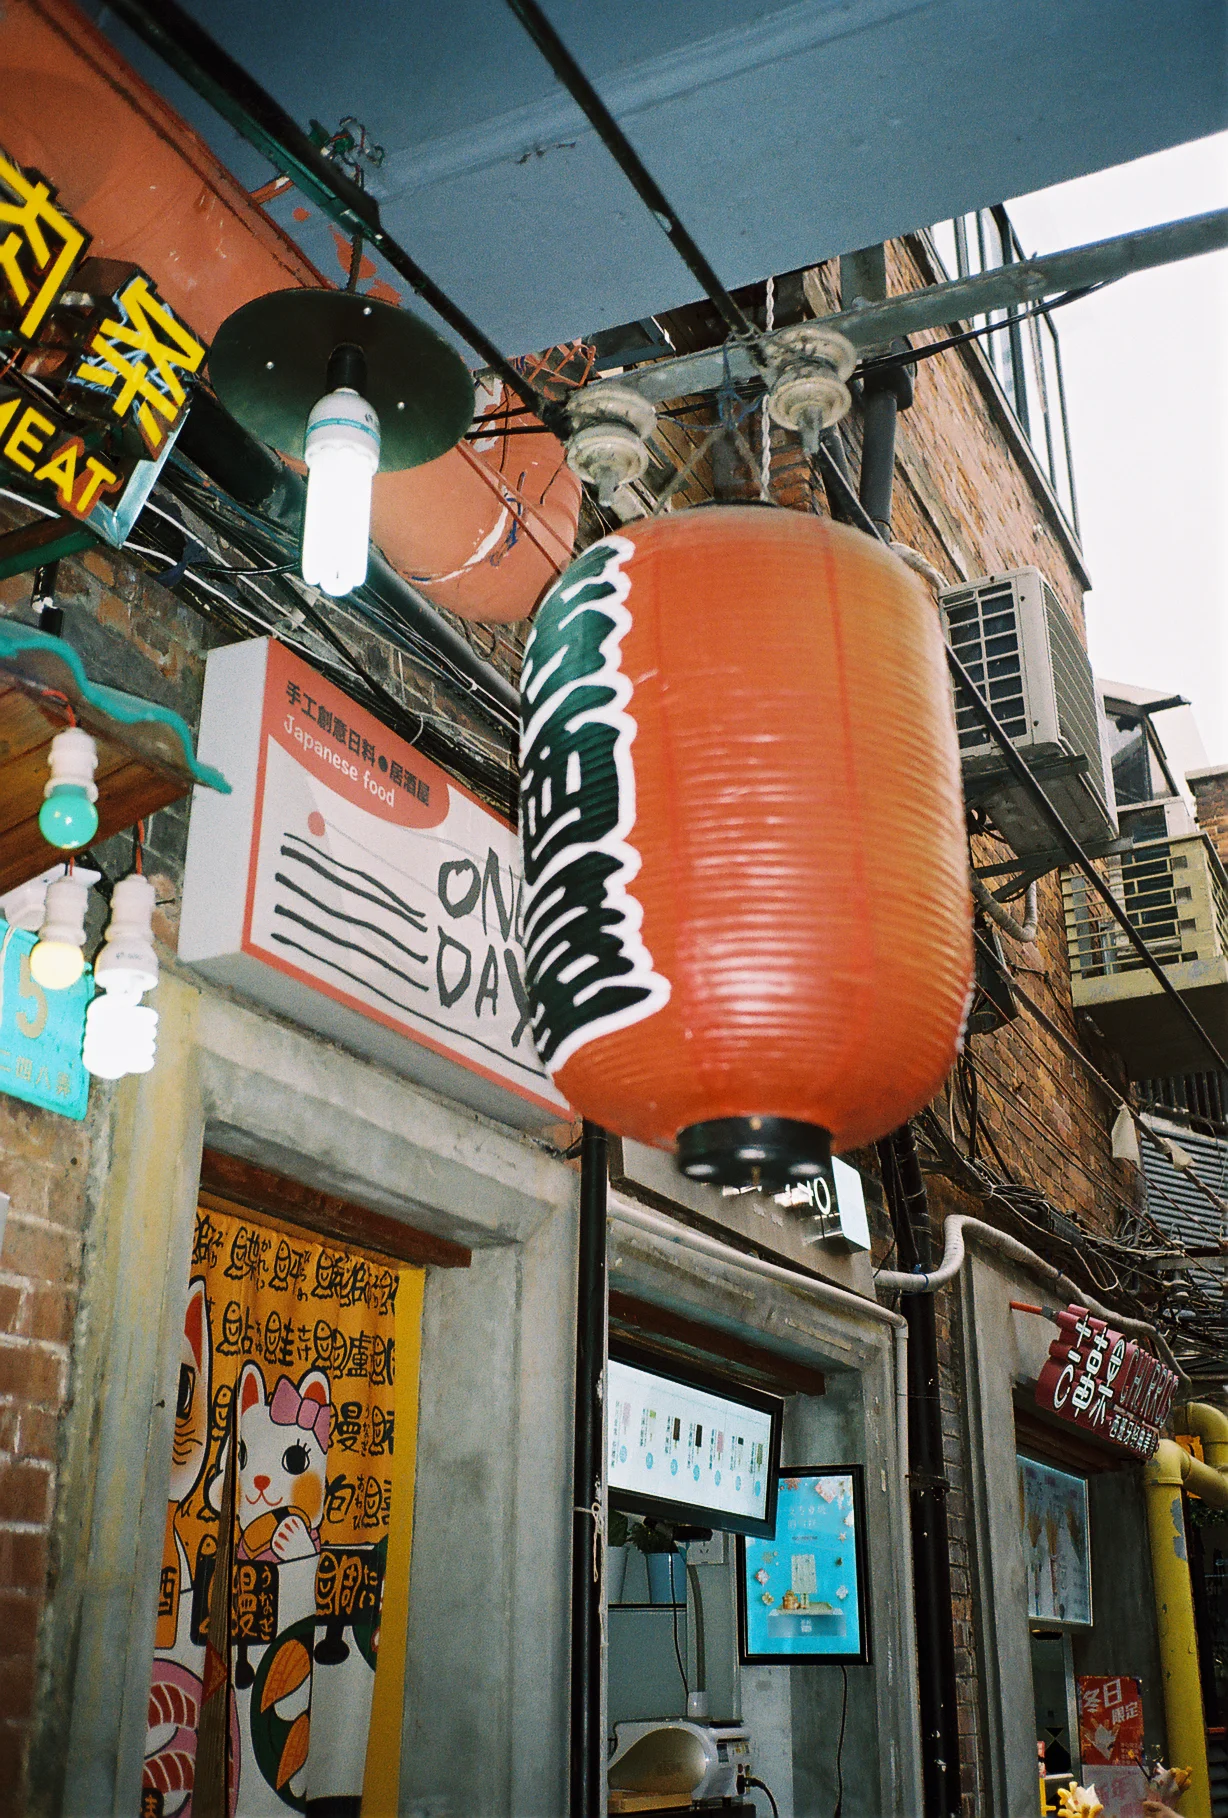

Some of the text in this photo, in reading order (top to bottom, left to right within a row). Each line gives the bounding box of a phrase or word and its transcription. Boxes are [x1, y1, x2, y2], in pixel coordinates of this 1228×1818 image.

[284, 714, 396, 807] Japanese food
[1083, 1678, 1123, 1714] 冬日
[1111, 1702, 1140, 1726] 限定
